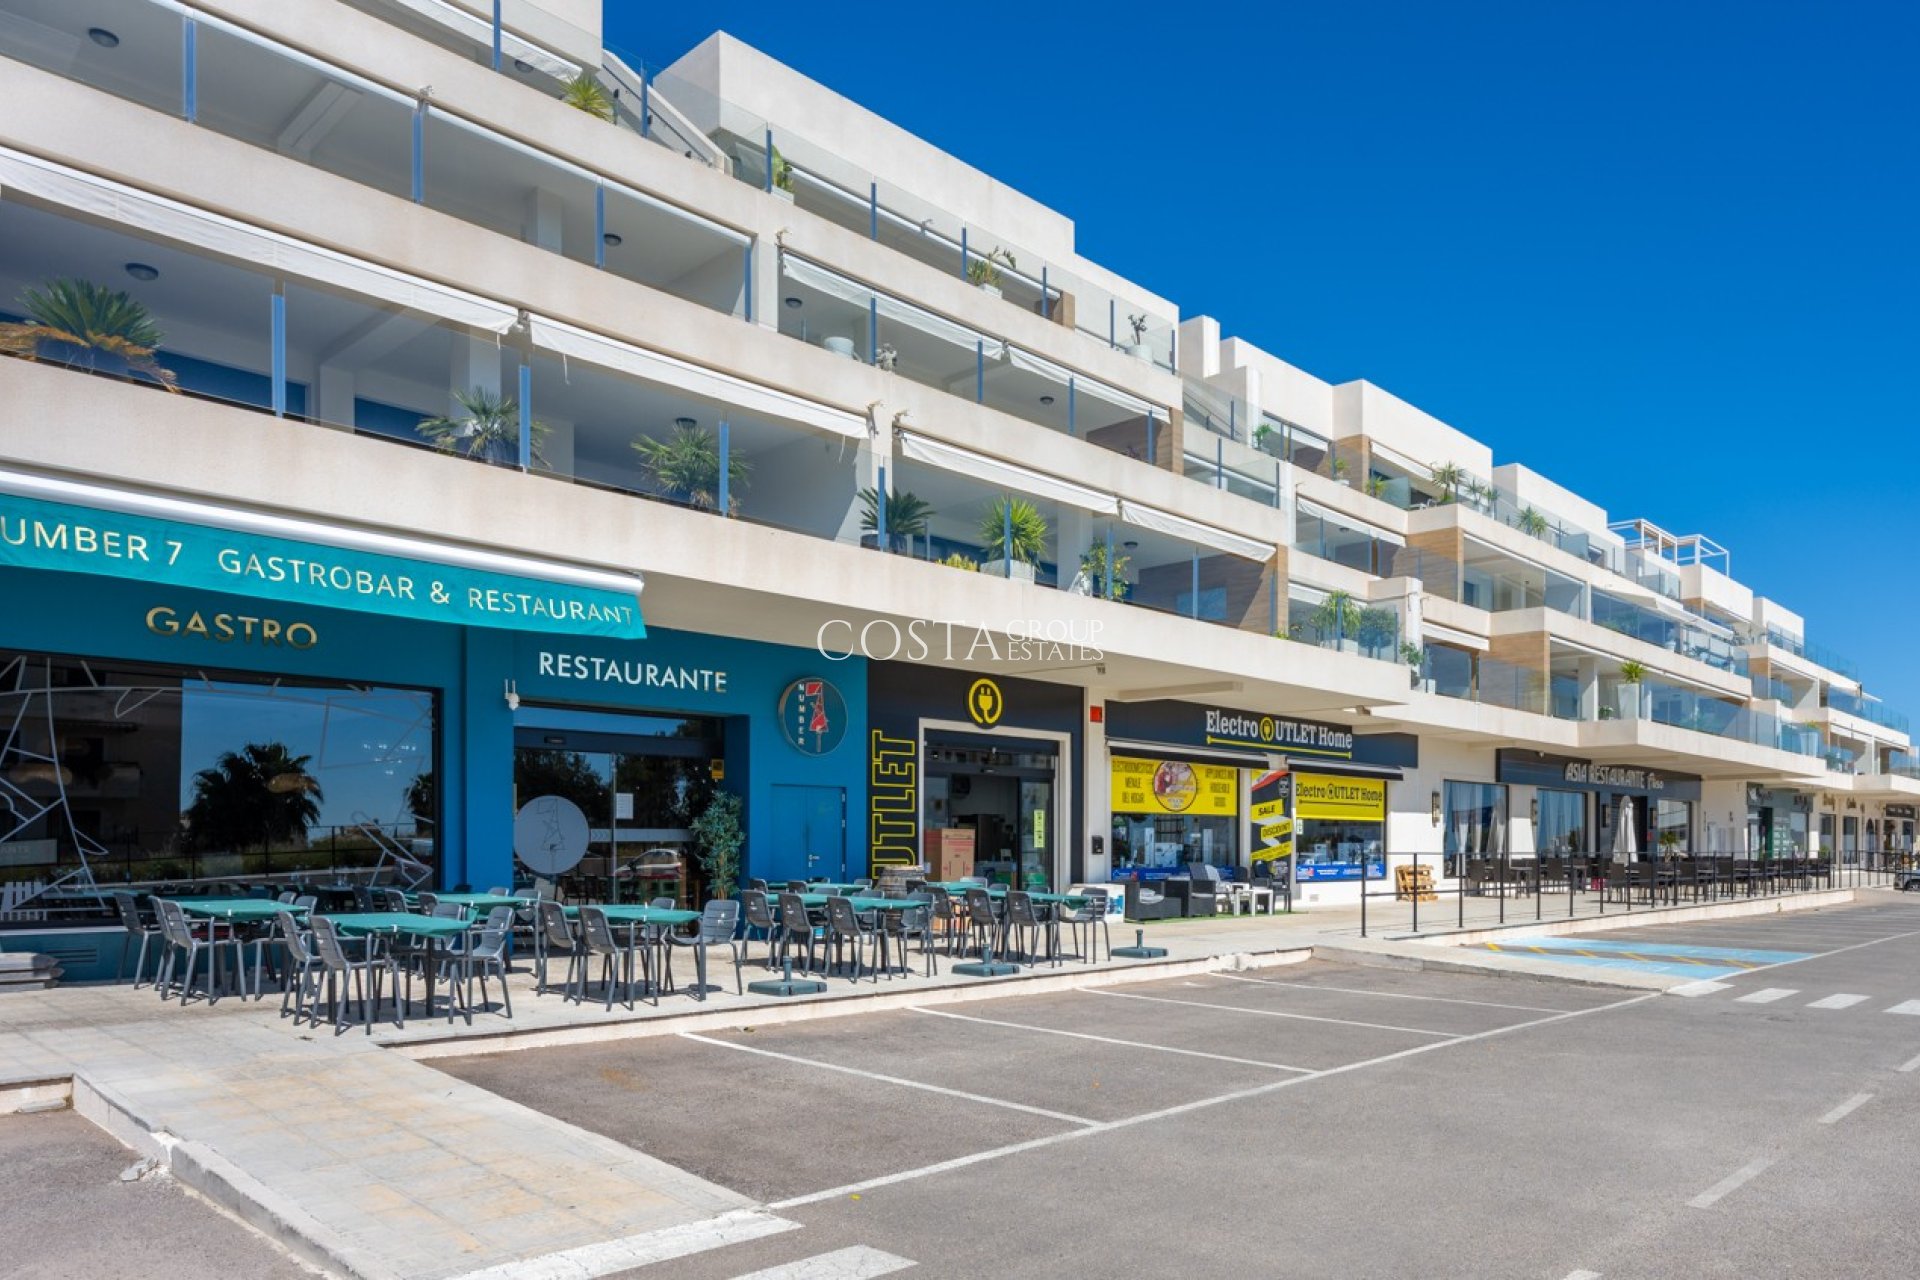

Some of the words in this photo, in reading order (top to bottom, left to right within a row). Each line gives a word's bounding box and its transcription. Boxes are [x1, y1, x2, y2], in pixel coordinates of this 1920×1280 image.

[166, 540, 183, 566] 7
[218, 548, 415, 600] GASTROBAR
[431, 580, 450, 604] &
[468, 587, 633, 626] RESTAURANT
[146, 606, 318, 650] GASTRO
[538, 651, 727, 693] RESTAURANTE
[797, 683, 806, 745] NUMBER
[1318, 725, 1353, 749] Home
[1565, 761, 1587, 783] ASIA
[1588, 764, 1645, 789] RESTAURANTE
[1258, 805, 1275, 816] SALE
[1361, 787, 1382, 802] Home
